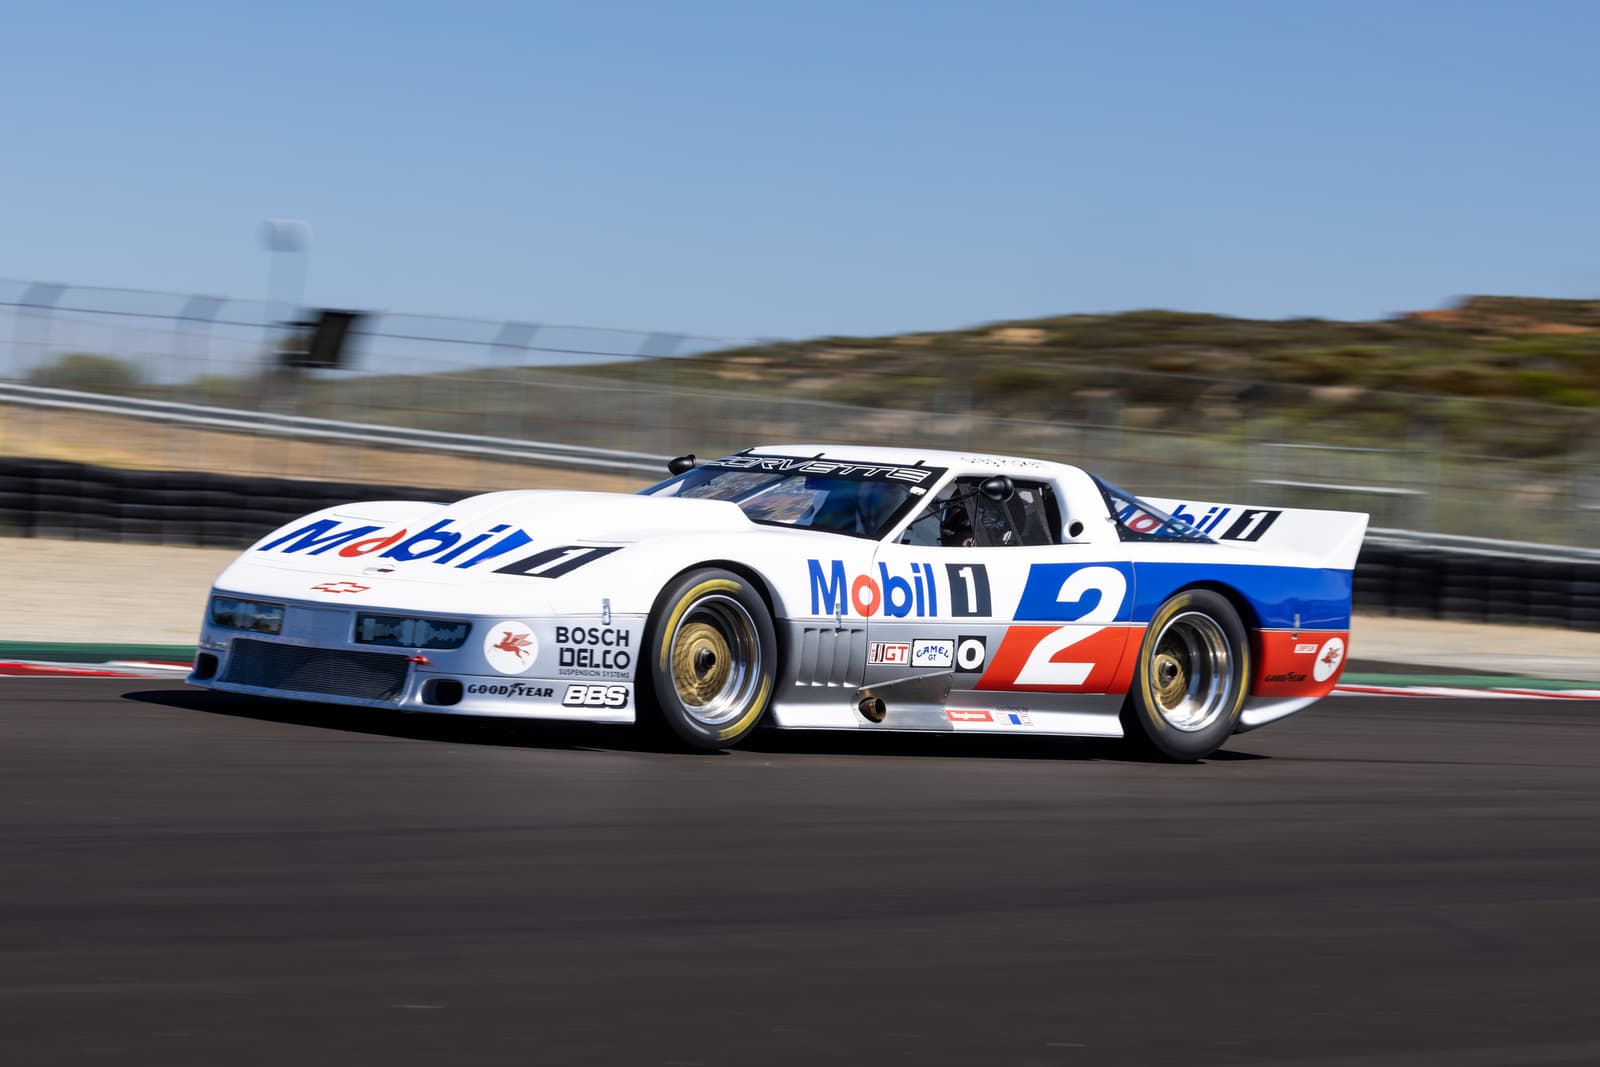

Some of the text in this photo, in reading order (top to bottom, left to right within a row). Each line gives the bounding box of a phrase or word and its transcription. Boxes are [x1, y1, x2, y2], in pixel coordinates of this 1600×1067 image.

[256, 518, 533, 569] Mobil
[807, 559, 938, 618] Mobil
[556, 626, 630, 647] BOSCH
[1012, 566, 1127, 686] 2
[558, 647, 630, 669] DELCO
[916, 645, 949, 659] CAMEL
[928, 653, 937, 661] GT
[559, 668, 630, 678] SUSPENSION SYSTEMS
[467, 682, 554, 699] GOODYEAR
[561, 684, 629, 709] BBS
